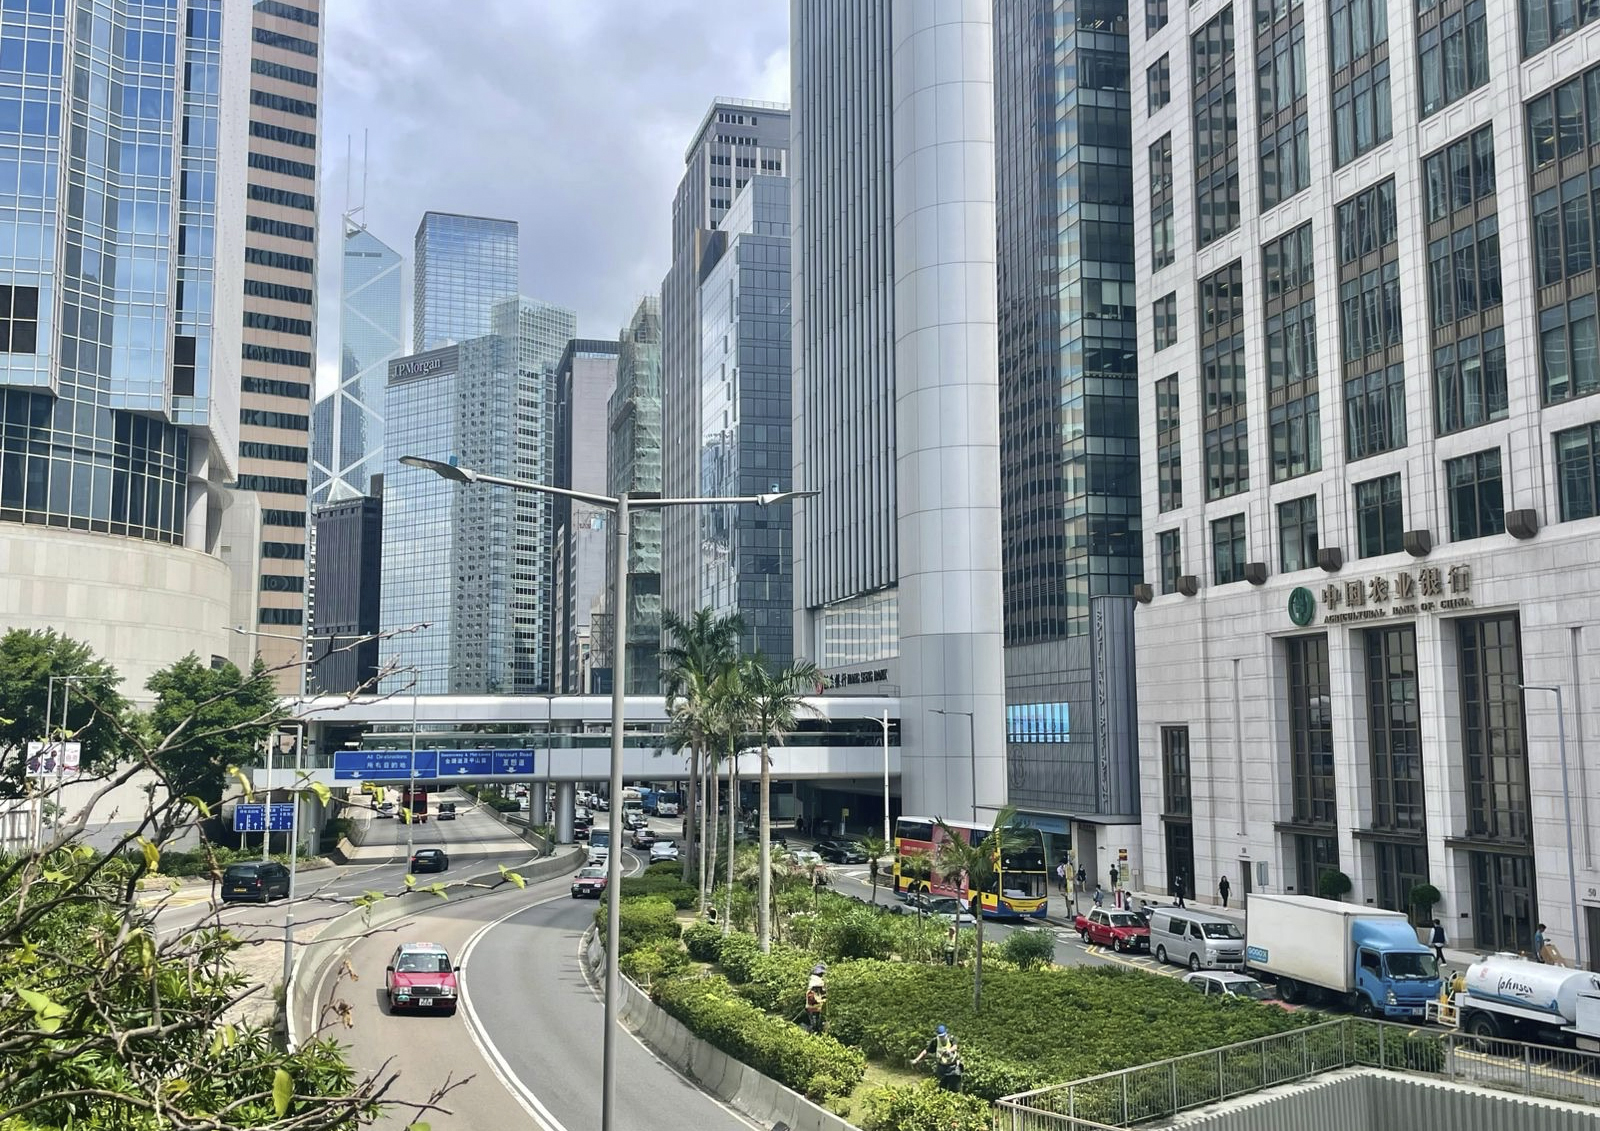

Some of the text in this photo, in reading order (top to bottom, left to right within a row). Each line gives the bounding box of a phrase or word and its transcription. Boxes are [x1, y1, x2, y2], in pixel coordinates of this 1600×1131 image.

[1322, 564, 1471, 610] 中国农业银行
[1324, 597, 1473, 624] AGRICULTURAL BANK OF CHINA
[1497, 976, 1533, 997] Johnson
